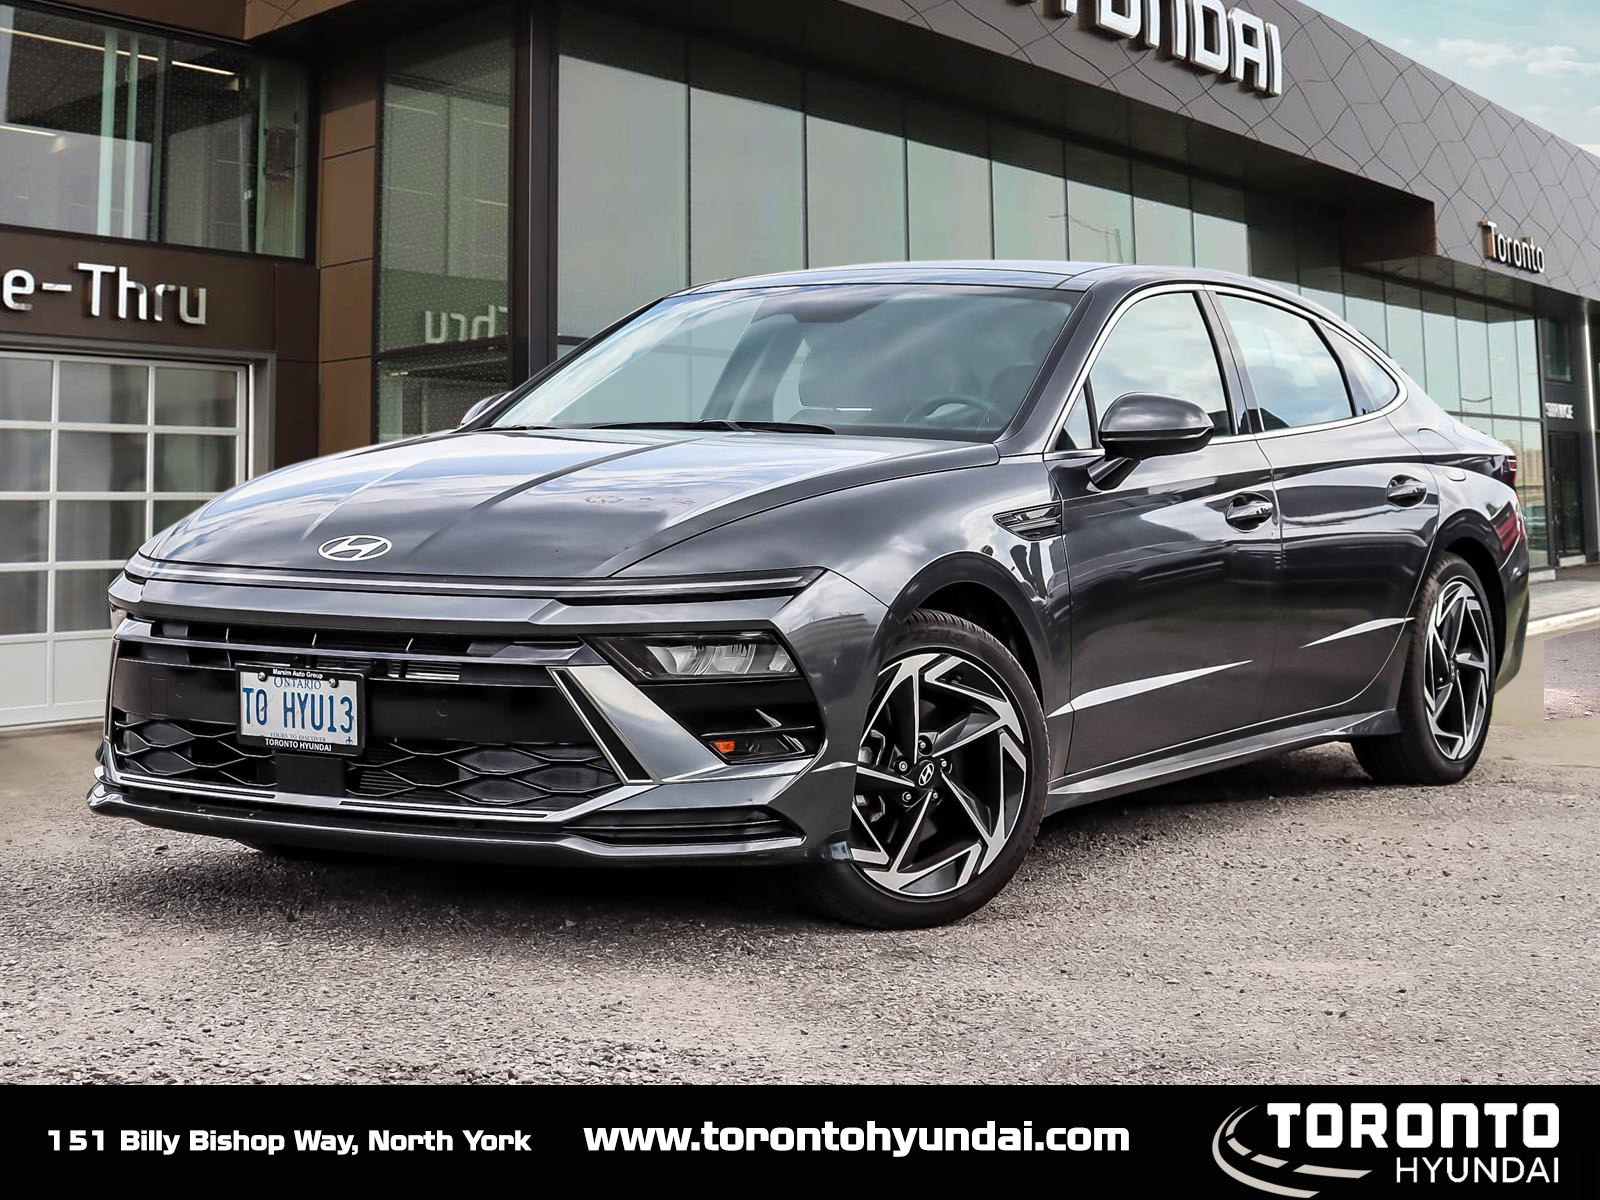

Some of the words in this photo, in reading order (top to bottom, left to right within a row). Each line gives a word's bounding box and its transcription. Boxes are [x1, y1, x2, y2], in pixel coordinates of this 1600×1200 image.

[1060, 0, 1283, 97] UNDAI
[1486, 220, 1545, 274] Toronto
[274, 677, 322, 690] ONTARIO
[293, 670, 305, 678] Auto
[306, 672, 324, 680] Group
[283, 692, 353, 733] HYU13
[265, 738, 299, 749] TORONTO
[299, 741, 332, 752] HYUNDAI
